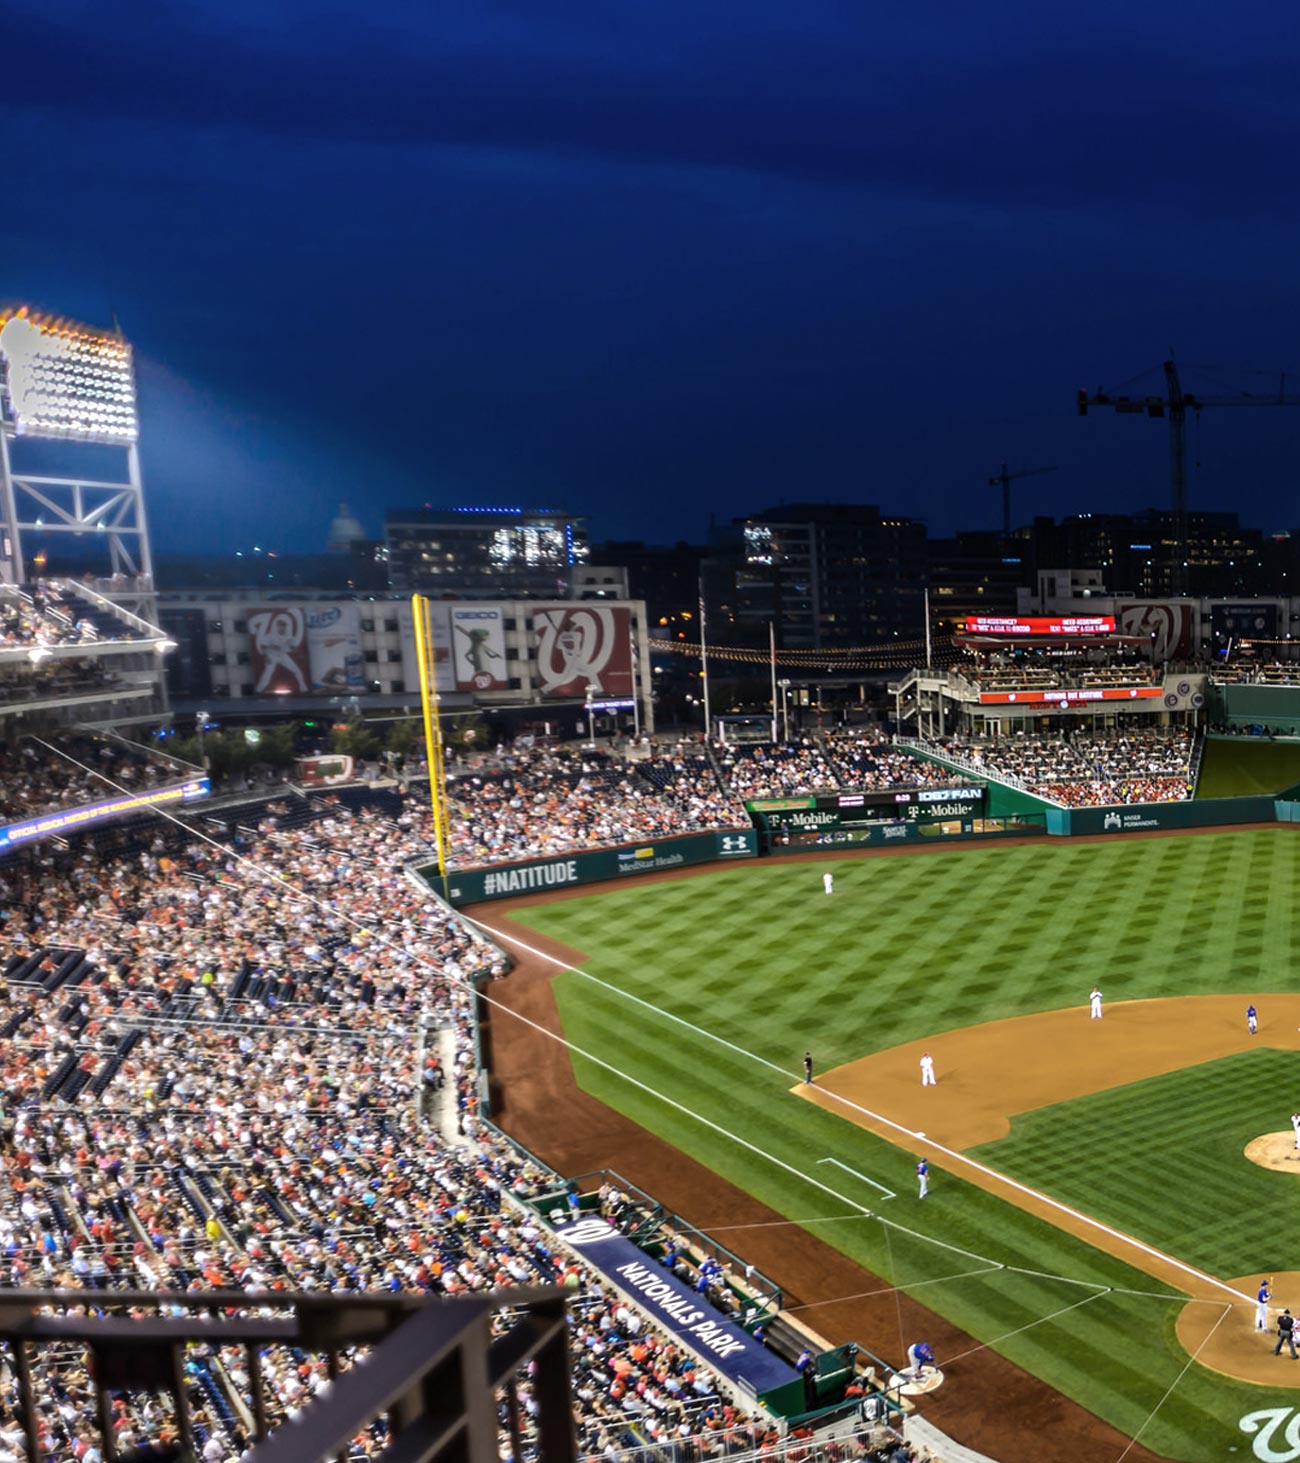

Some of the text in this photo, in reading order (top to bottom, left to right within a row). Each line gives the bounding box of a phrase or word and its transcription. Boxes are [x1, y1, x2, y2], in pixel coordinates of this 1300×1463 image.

[456, 610, 499, 620] GEICO
[951, 788, 982, 799] FAN
[483, 861, 578, 896] #NATITUDE
[616, 1261, 746, 1359] NATIONALS PARK
